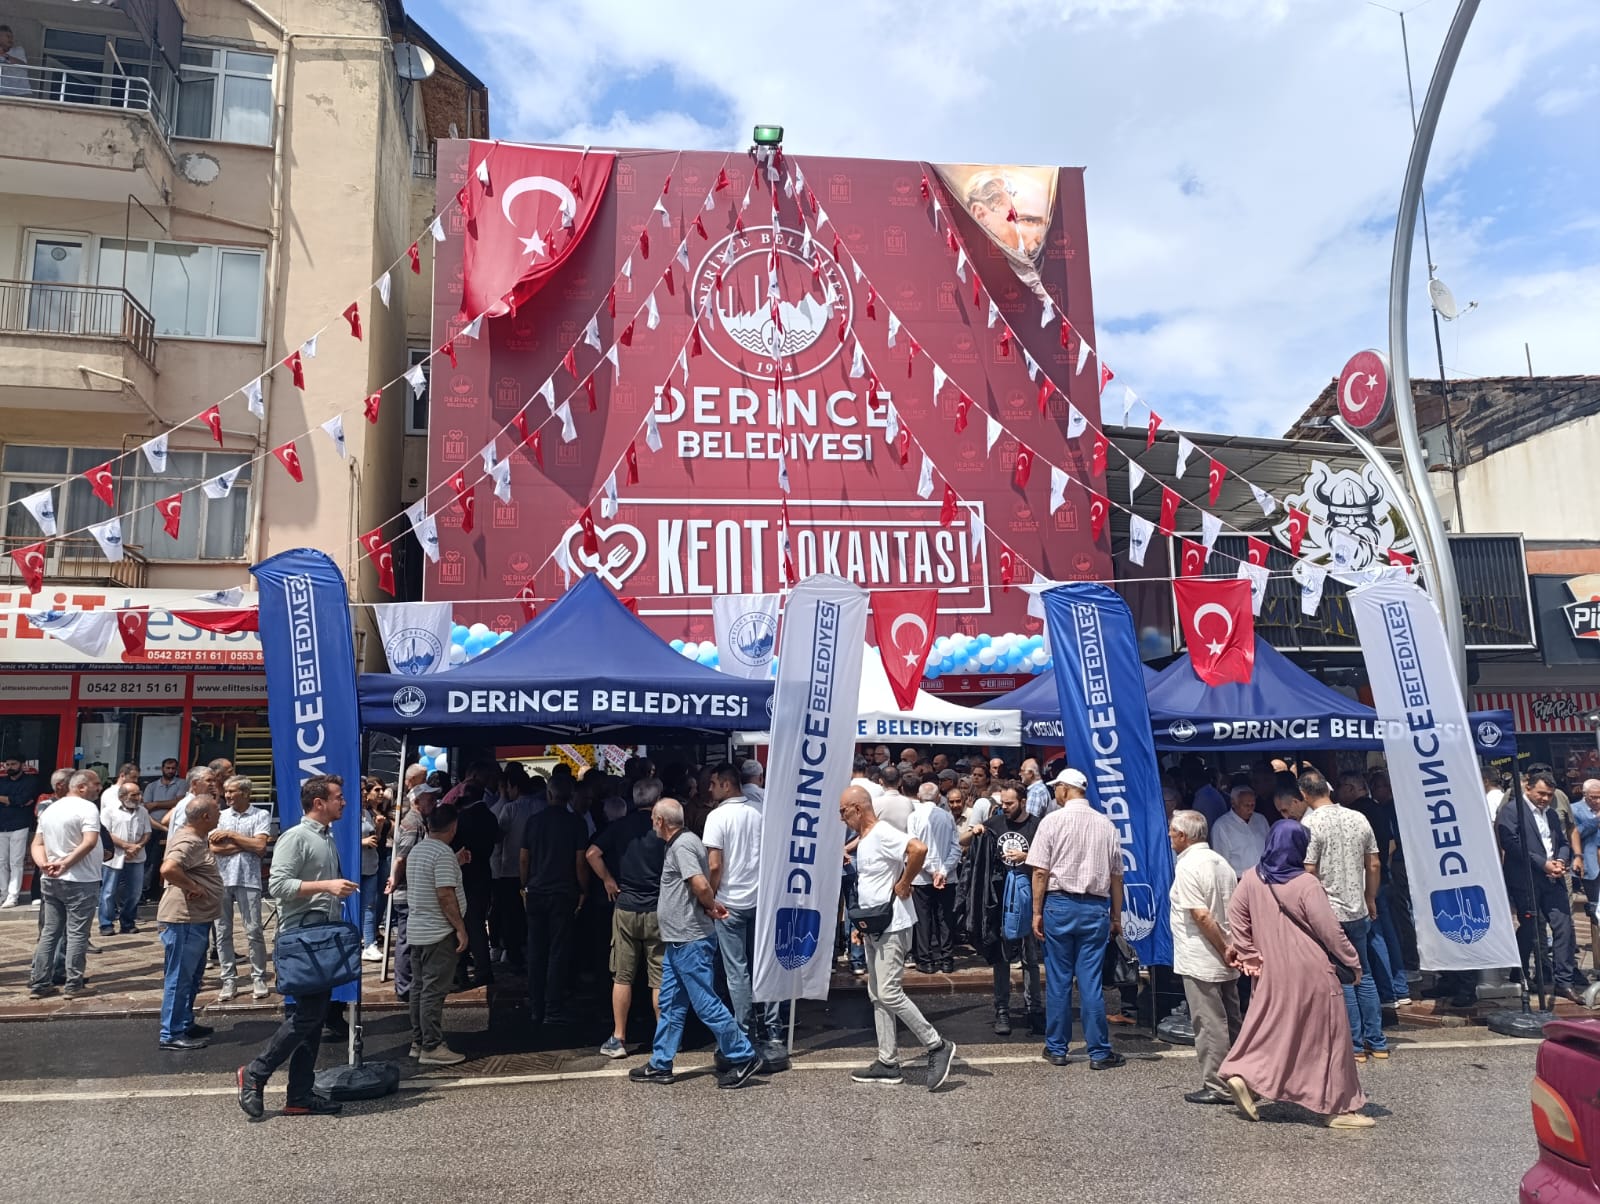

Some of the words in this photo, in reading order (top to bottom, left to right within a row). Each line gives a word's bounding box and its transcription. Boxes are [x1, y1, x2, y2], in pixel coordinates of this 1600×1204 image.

[756, 362, 793, 374] 194
[658, 519, 769, 594] KENT
[1574, 607, 1600, 629] Pi
[147, 651, 172, 660] 0542
[174, 651, 192, 660] 821
[195, 651, 208, 660] 51
[210, 651, 222, 660] 61
[230, 652, 254, 660] 0553
[87, 683, 117, 693] 0542
[120, 683, 142, 693] 821
[146, 683, 160, 693] 51
[164, 683, 178, 692] 61
[196, 683, 268, 692] www.elittesisat
